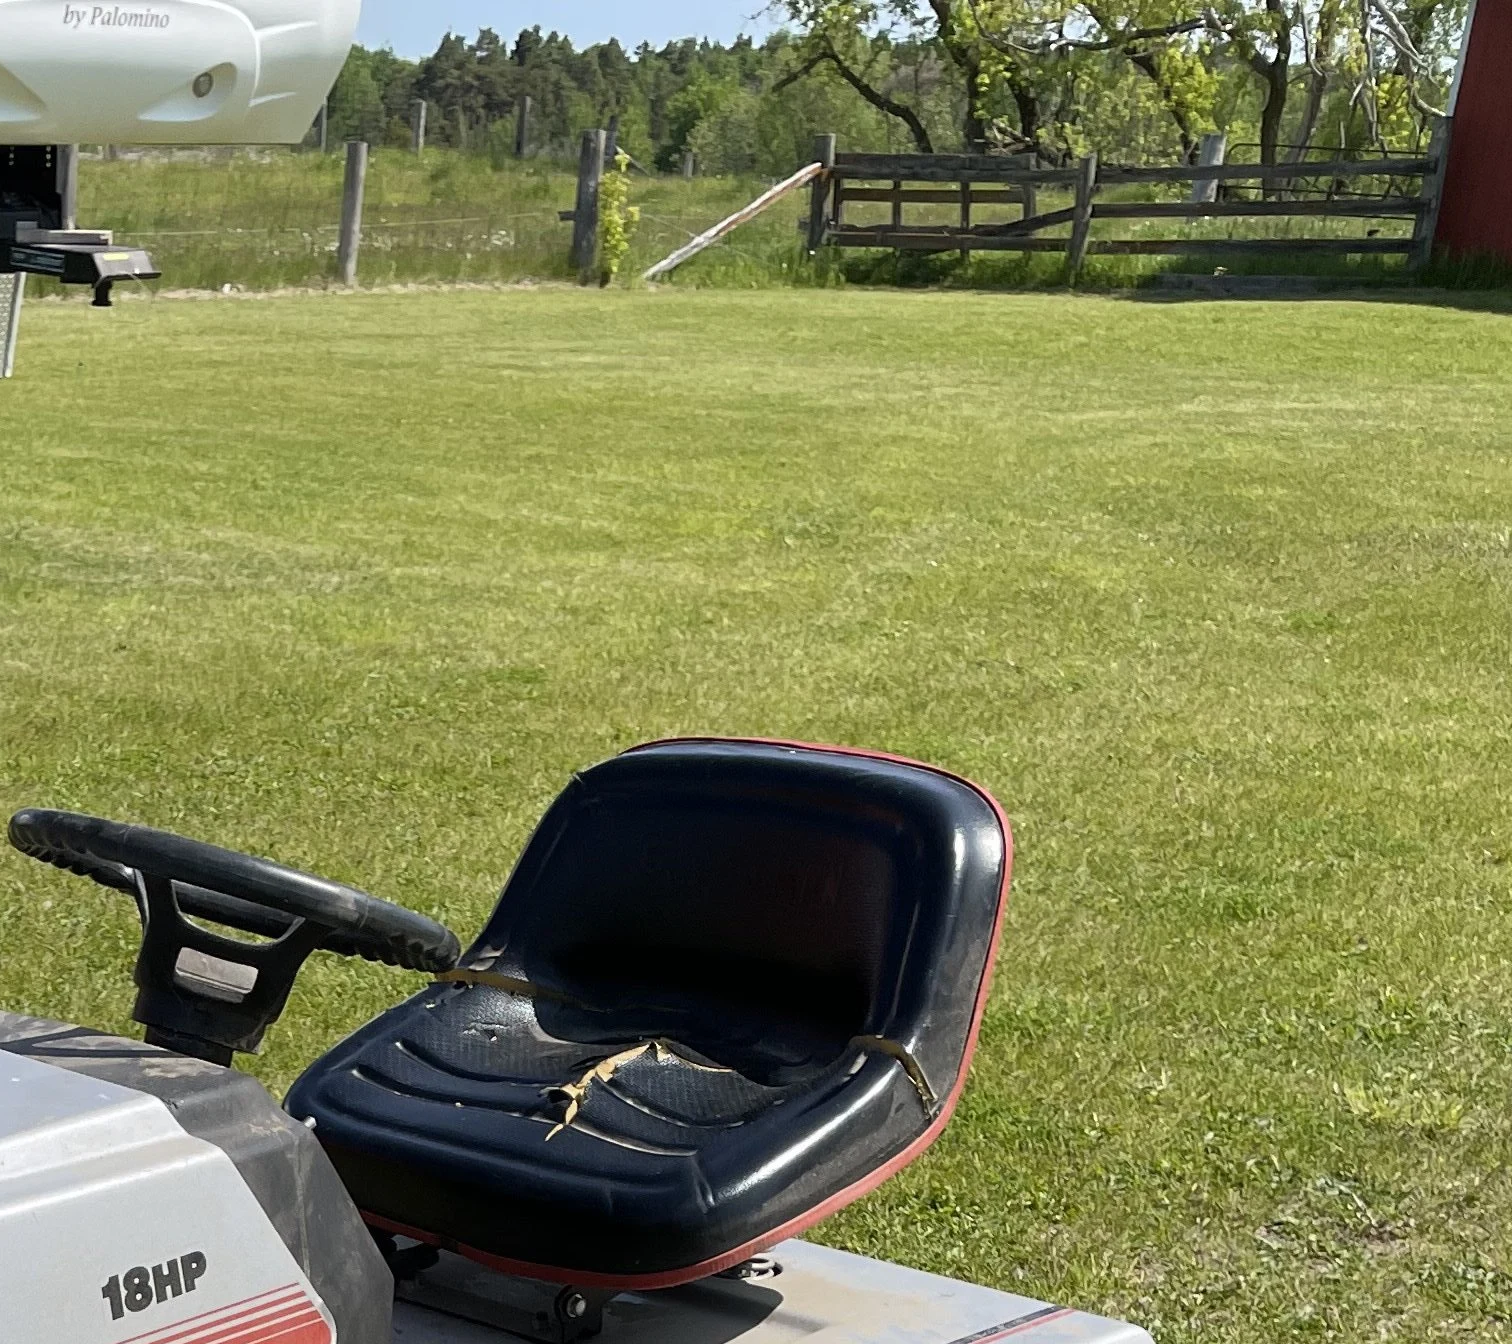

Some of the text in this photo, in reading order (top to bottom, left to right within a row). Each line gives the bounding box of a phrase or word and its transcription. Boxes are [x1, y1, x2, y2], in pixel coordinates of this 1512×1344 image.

[63, 3, 170, 29] by Palomino
[102, 1251, 208, 1321] 18HP
